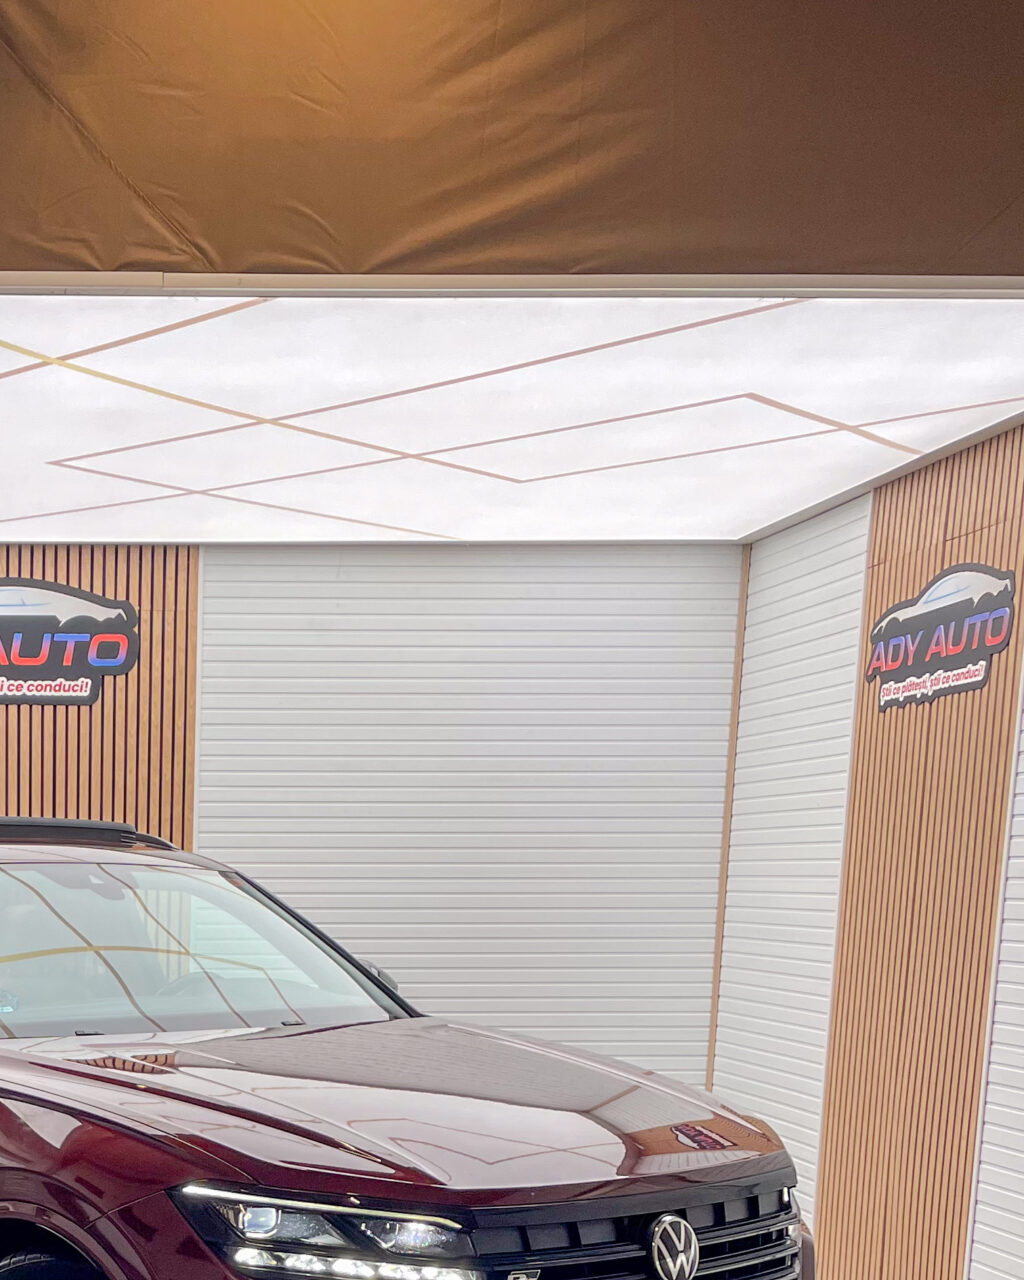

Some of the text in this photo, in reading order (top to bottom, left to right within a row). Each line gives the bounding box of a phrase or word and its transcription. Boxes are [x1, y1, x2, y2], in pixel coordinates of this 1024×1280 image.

[867, 607, 1010, 675] ADY AUTO
[7, 682, 24, 693] ce
[27, 681, 89, 693] conduci!
